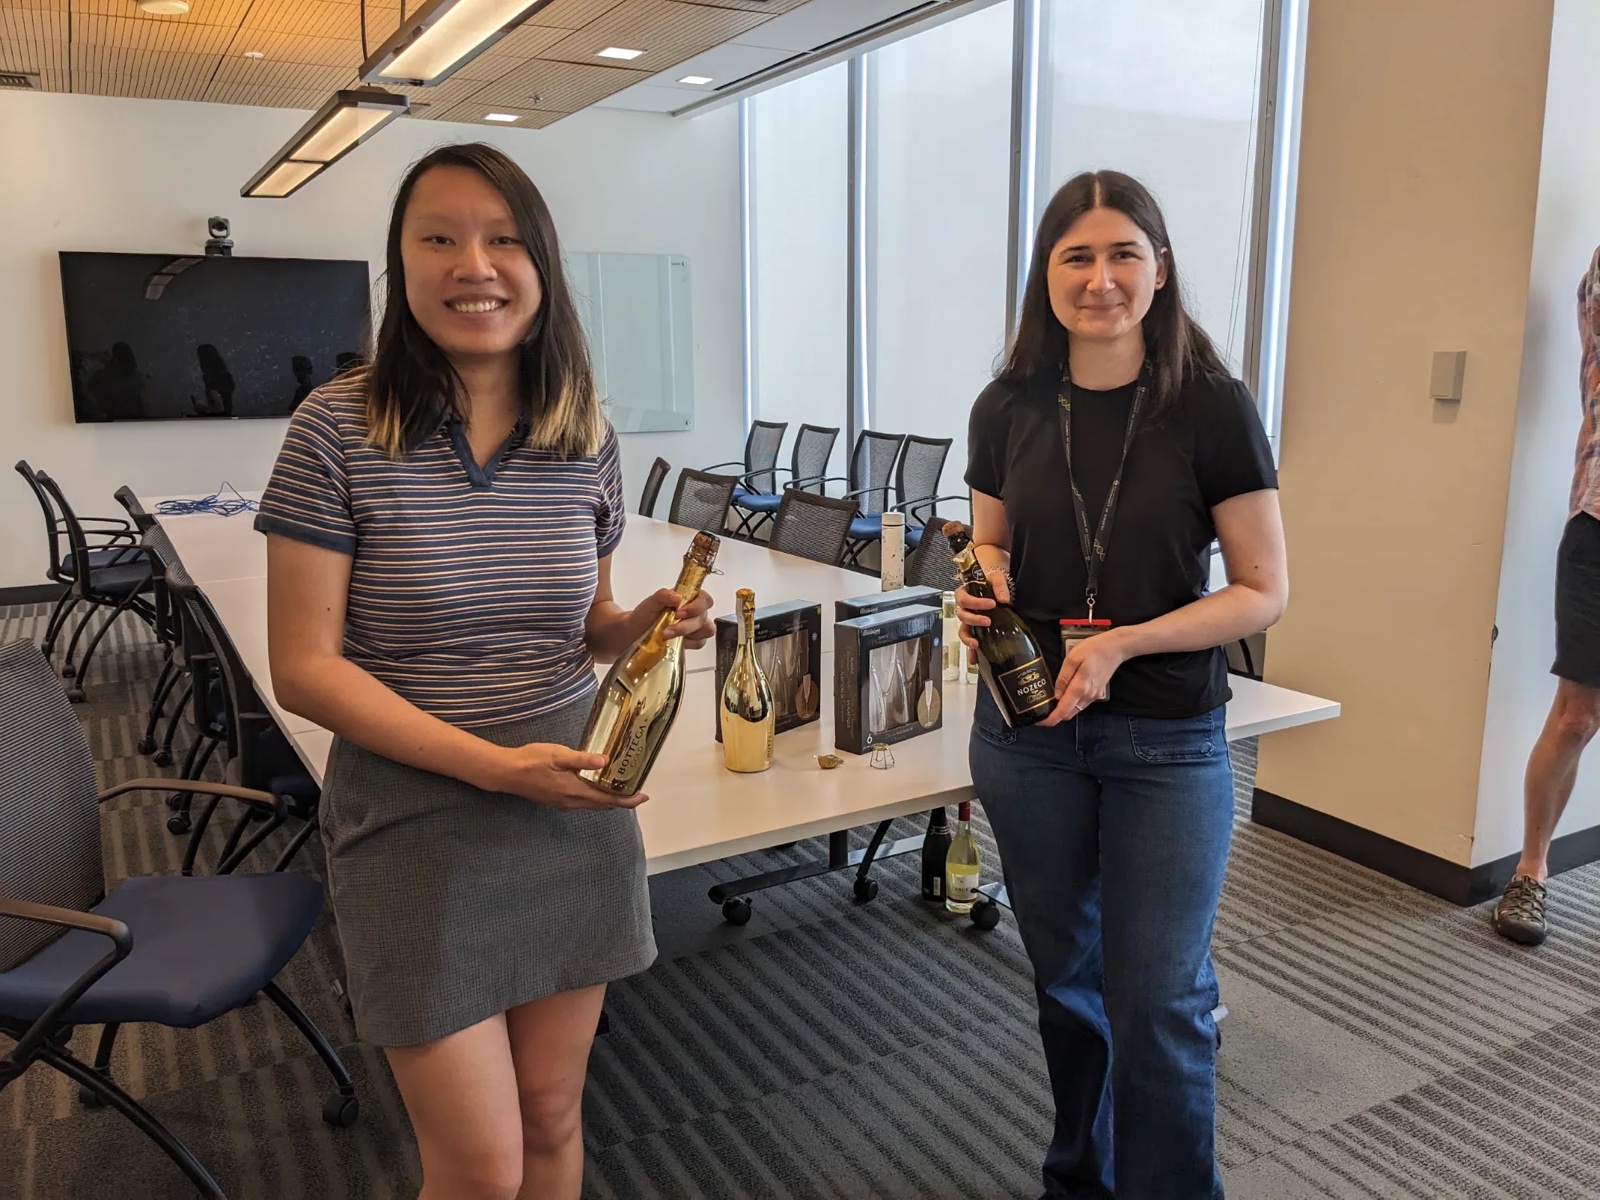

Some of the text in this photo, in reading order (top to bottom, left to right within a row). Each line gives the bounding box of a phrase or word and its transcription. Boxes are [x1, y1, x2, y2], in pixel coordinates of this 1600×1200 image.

[1017, 678, 1046, 696] NOZECO
[866, 733, 873, 744] 6
[618, 724, 647, 775] BOTTEGA
[630, 746, 645, 768] GOLD
